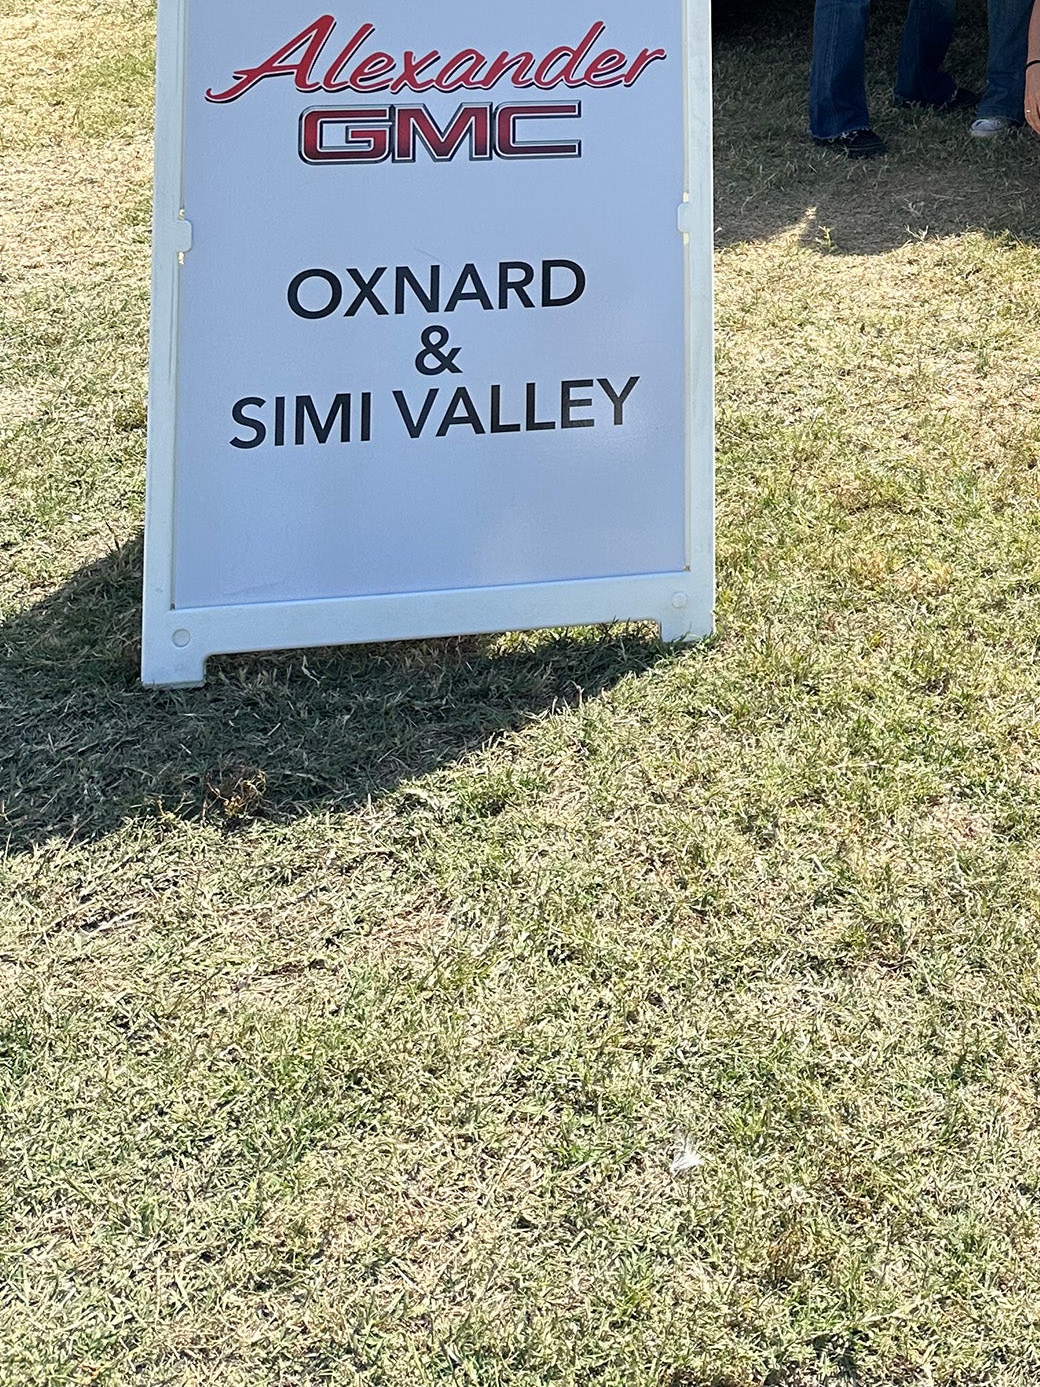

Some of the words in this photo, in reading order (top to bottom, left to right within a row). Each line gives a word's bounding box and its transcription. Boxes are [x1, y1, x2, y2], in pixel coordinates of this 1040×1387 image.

[204, 14, 667, 104] Alexander
[297, 99, 582, 166] GMC
[286, 258, 586, 320] OXNARD
[414, 324, 464, 377] &
[228, 391, 372, 450] SIMI
[391, 375, 642, 439] VALLEY
